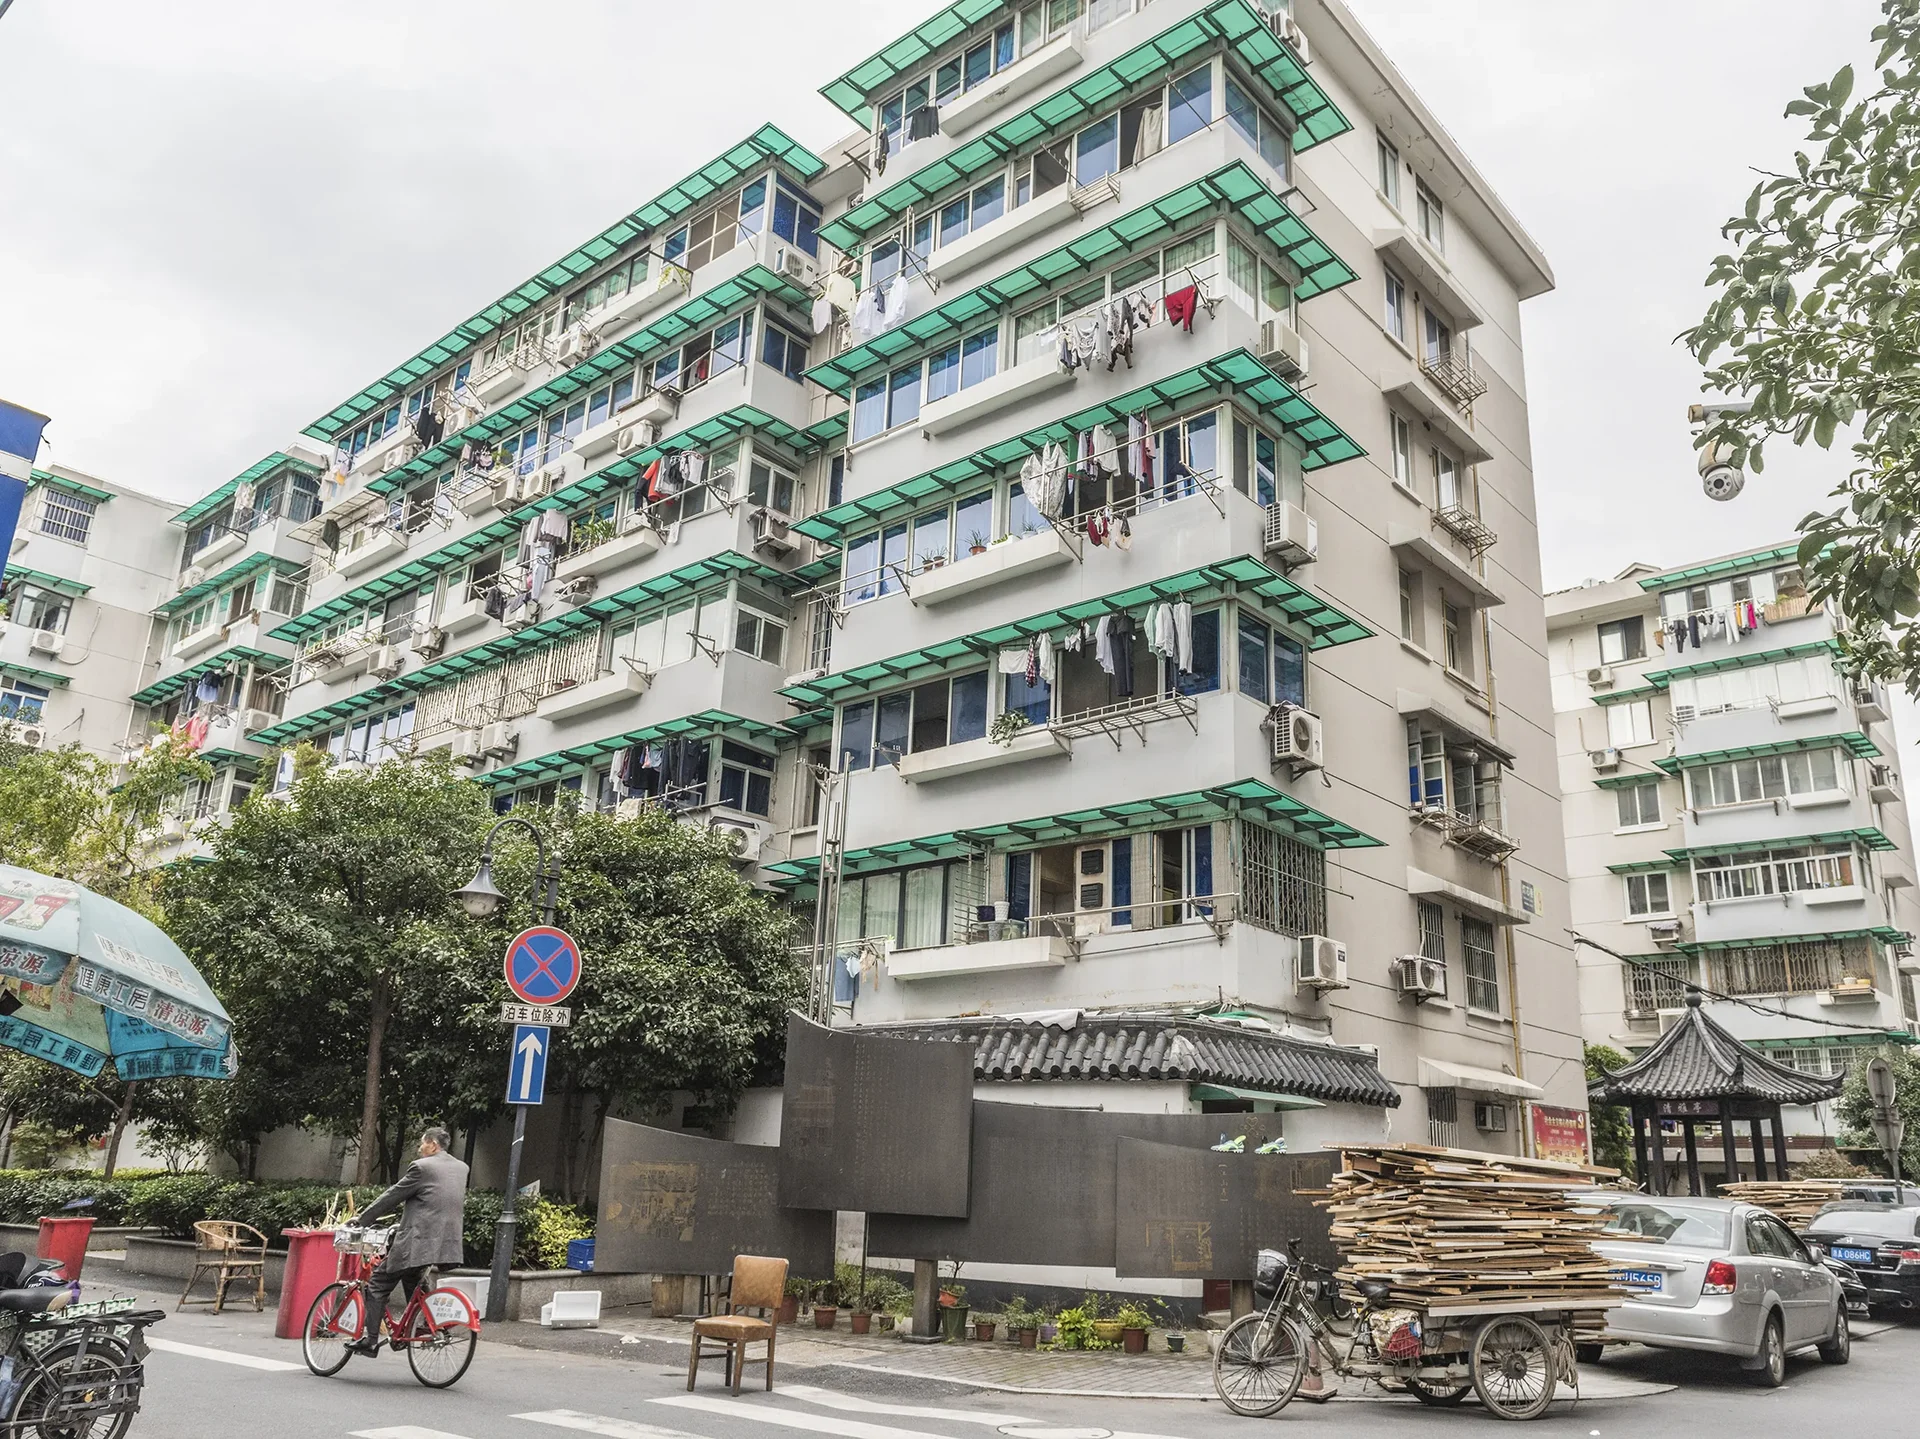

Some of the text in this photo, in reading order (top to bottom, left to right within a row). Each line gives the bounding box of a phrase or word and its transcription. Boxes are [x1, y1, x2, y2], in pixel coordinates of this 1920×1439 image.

[80, 966, 150, 1010] 健康工房
[154, 1000, 210, 1036] 清凉源
[504, 1005, 568, 1023] 泊车位除外
